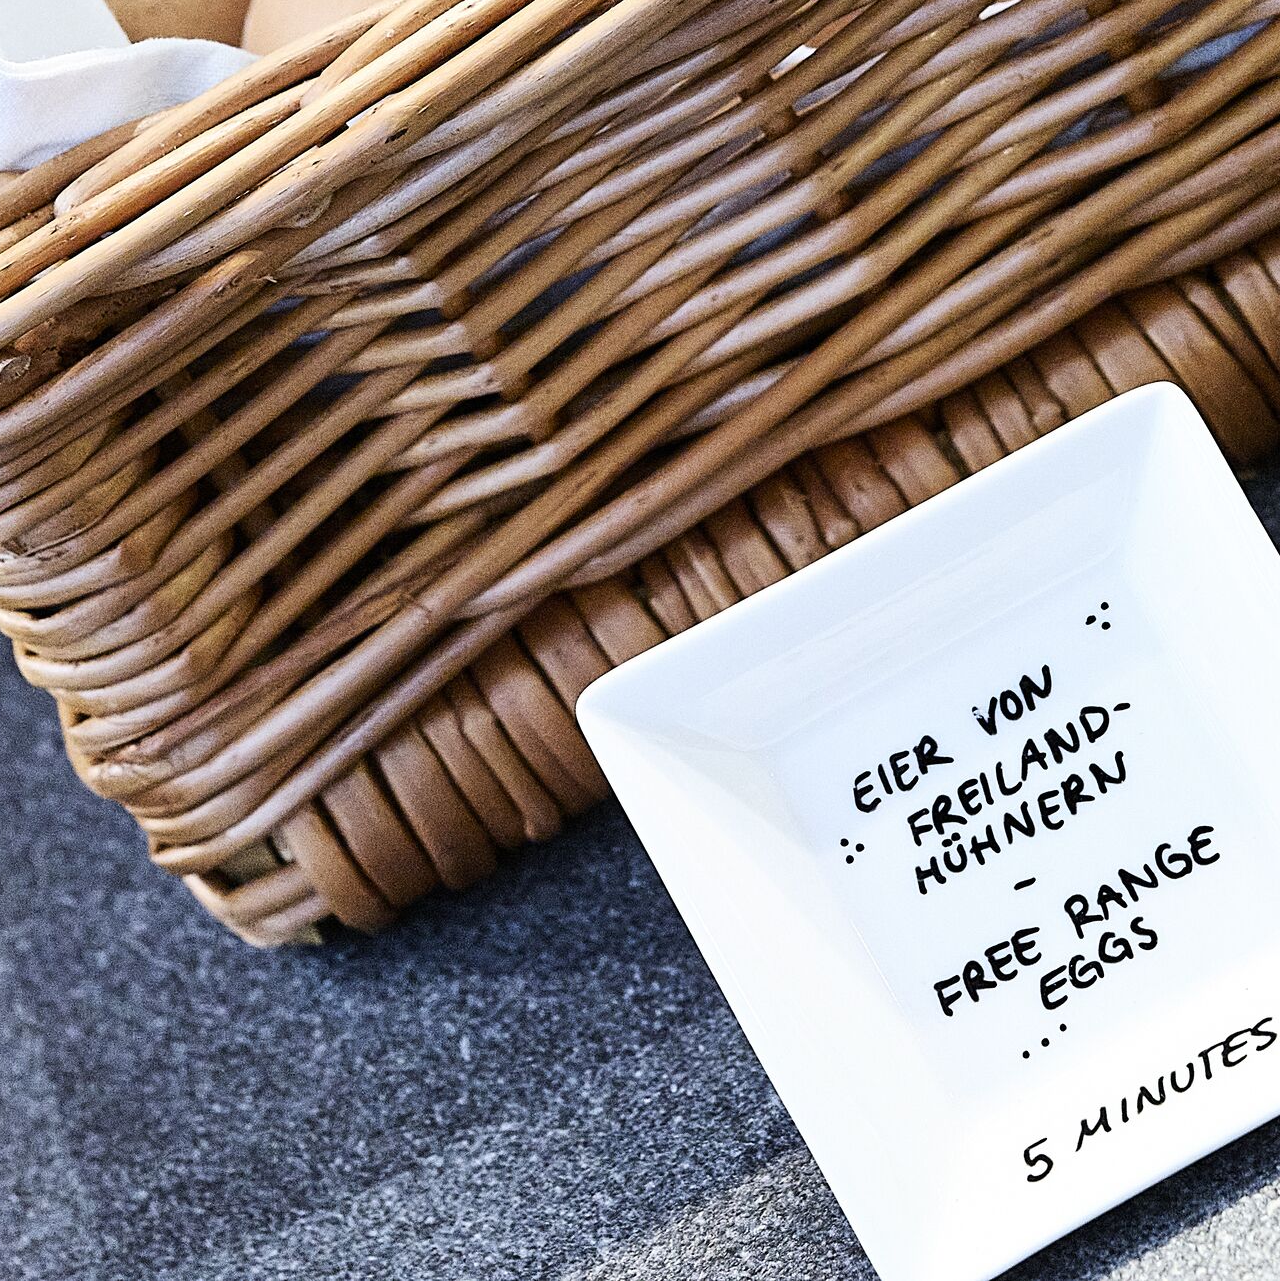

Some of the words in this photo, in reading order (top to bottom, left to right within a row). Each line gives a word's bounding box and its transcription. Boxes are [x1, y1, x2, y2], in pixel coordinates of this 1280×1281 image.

[852, 734, 955, 814] EIER
[971, 664, 1052, 736] VON
[906, 702, 1131, 847] FREILAND-
[914, 750, 1127, 896] HÜHNERN
[933, 926, 1042, 1017] FREE
[1063, 825, 1221, 940] RANGE
[1039, 916, 1159, 1011] EGGS
[1023, 1137, 1054, 1183] 5
[1074, 1016, 1278, 1152] MINUTES
